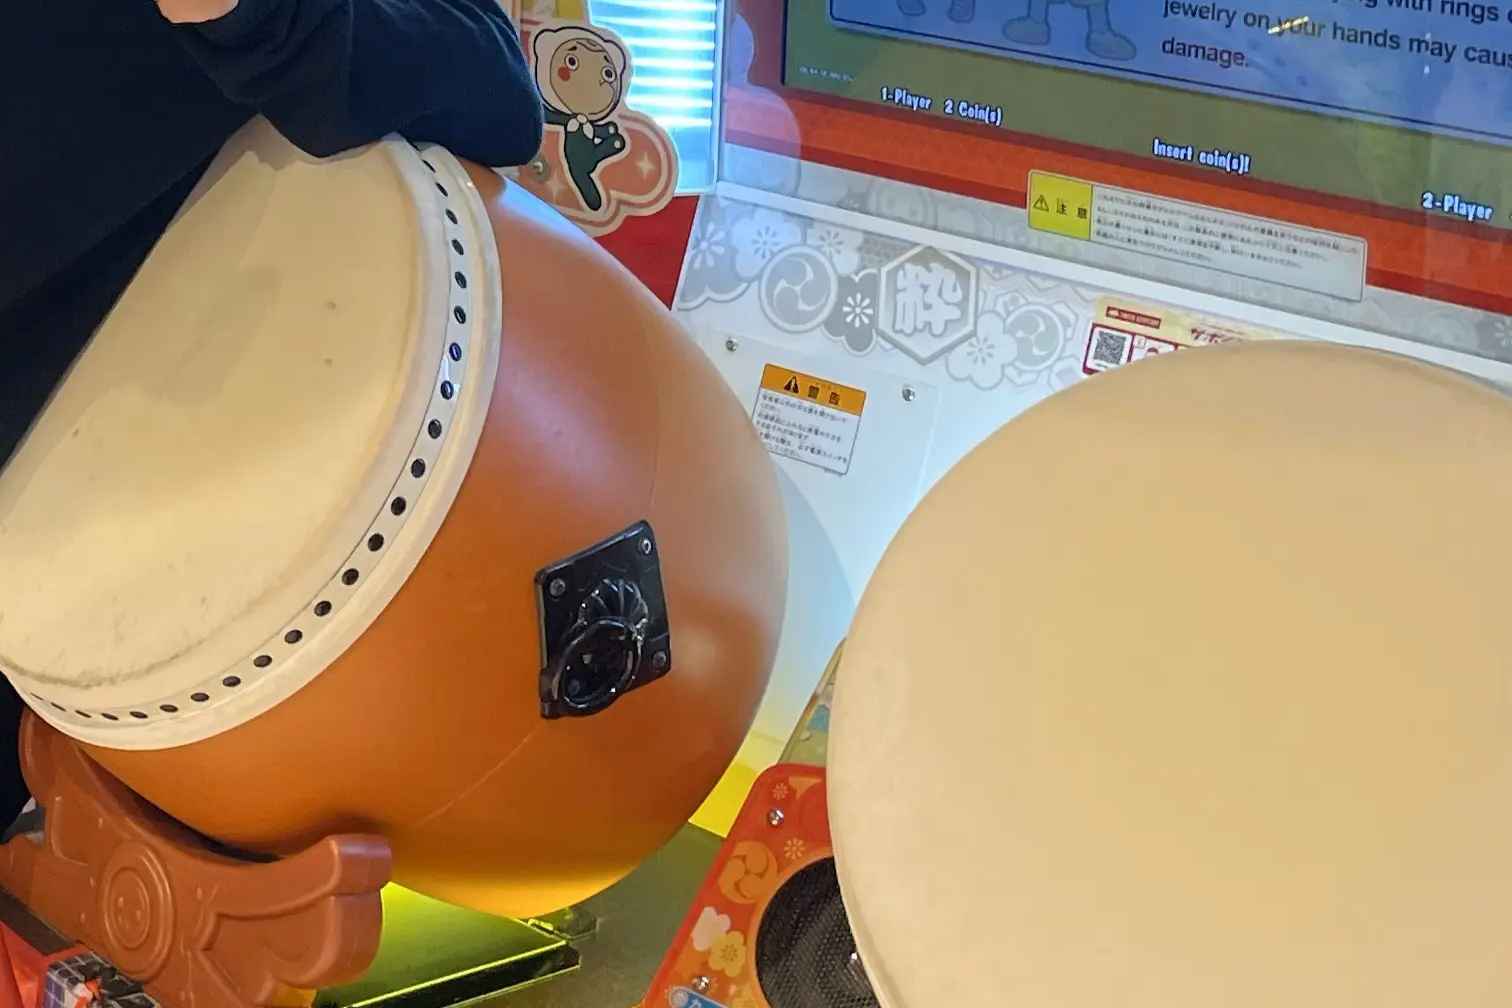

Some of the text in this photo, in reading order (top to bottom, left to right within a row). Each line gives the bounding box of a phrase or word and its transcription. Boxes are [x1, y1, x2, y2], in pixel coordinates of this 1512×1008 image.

[1161, 36, 1250, 68] damage.
[1244, 10, 1270, 29] on
[1277, 16, 1325, 38] your
[1332, 21, 1401, 50] hands
[1409, 36, 1457, 63] may
[881, 85, 1003, 128] 1-Player 2 Coin(s)
[1153, 137, 1251, 175] Insert coin(s)!
[1421, 191, 1493, 222] 2-Player
